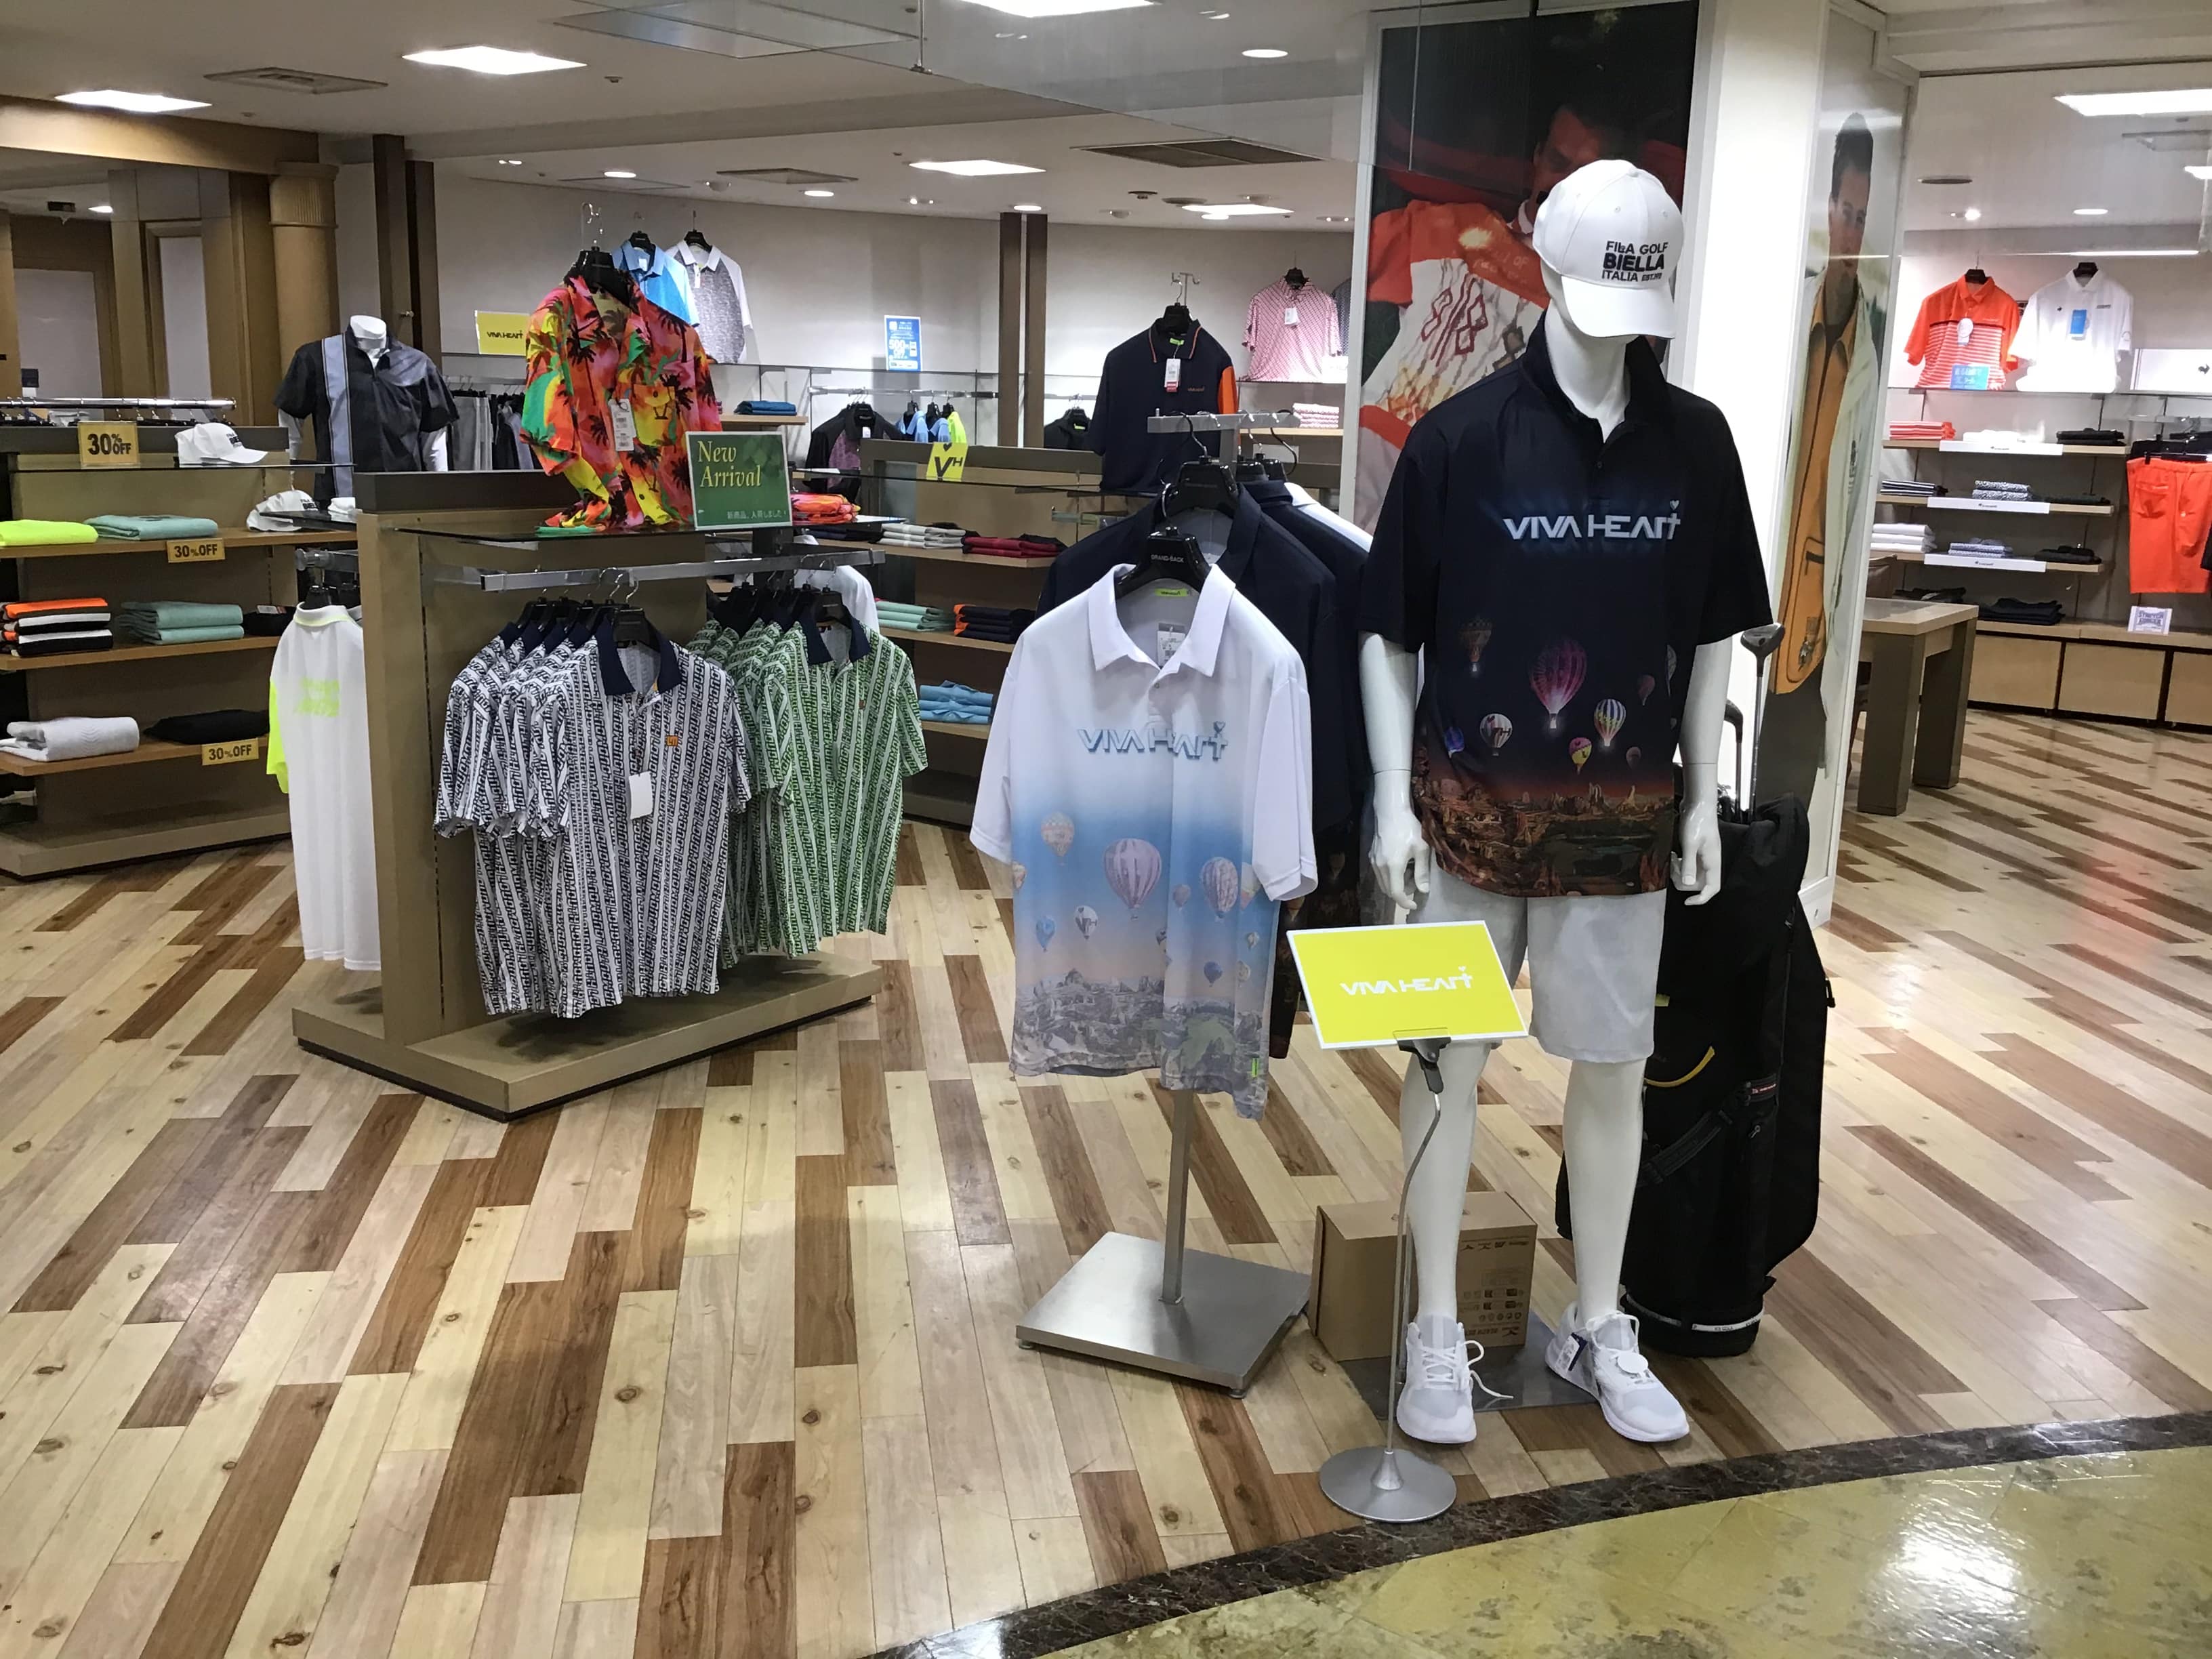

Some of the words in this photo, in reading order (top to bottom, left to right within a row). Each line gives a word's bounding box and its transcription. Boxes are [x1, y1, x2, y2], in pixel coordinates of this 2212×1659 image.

[1605, 241, 1635, 254] FILA
[1639, 242, 1668, 255] GOLF
[1603, 253, 1664, 272] BIELLA
[1601, 270, 1638, 282] ITALIA
[697, 441, 737, 462] New
[699, 464, 762, 487] Arrival
[1502, 515, 1582, 540] VIVA
[1587, 512, 1681, 540] HEART
[1078, 729, 1145, 753] VIVA
[1340, 981, 1397, 996] VIVA
[1398, 973, 1473, 993] HEART
